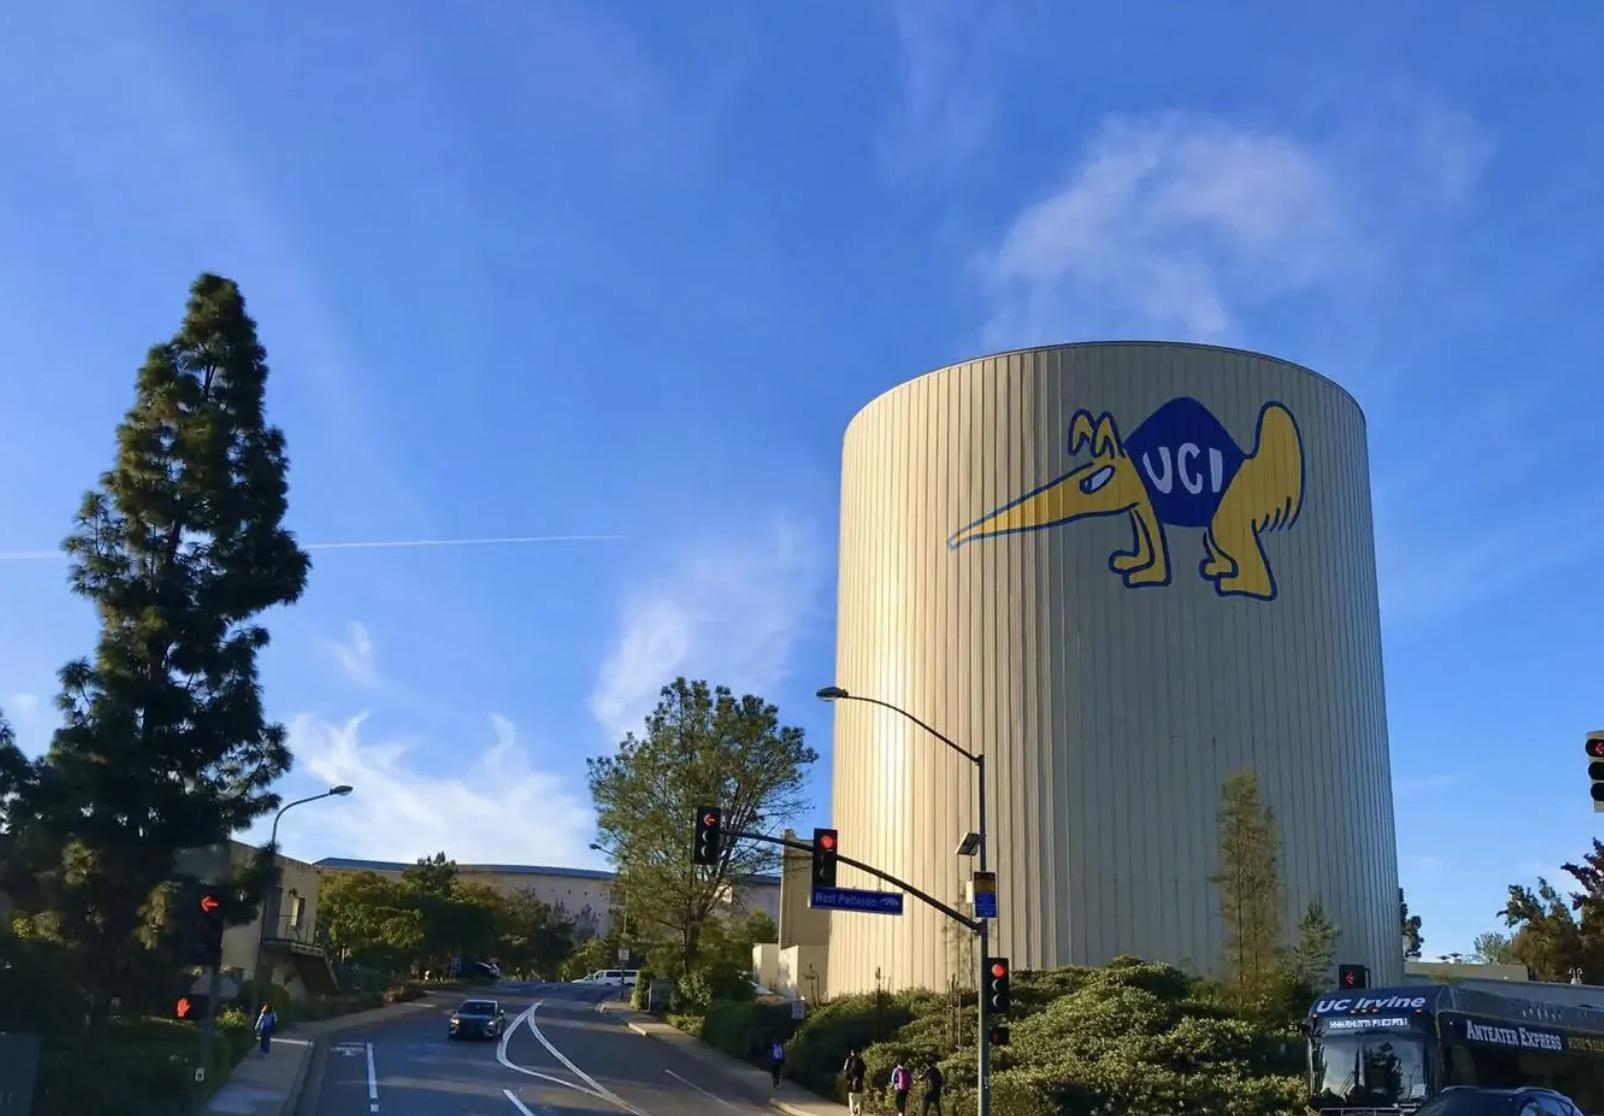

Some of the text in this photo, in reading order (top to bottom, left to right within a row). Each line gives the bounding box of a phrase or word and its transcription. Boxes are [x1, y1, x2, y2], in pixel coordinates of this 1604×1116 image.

[1142, 442, 1223, 494] UCI
[1316, 996, 1426, 1013] UC Irvine
[1519, 1027, 1562, 1050] EXPRESS
